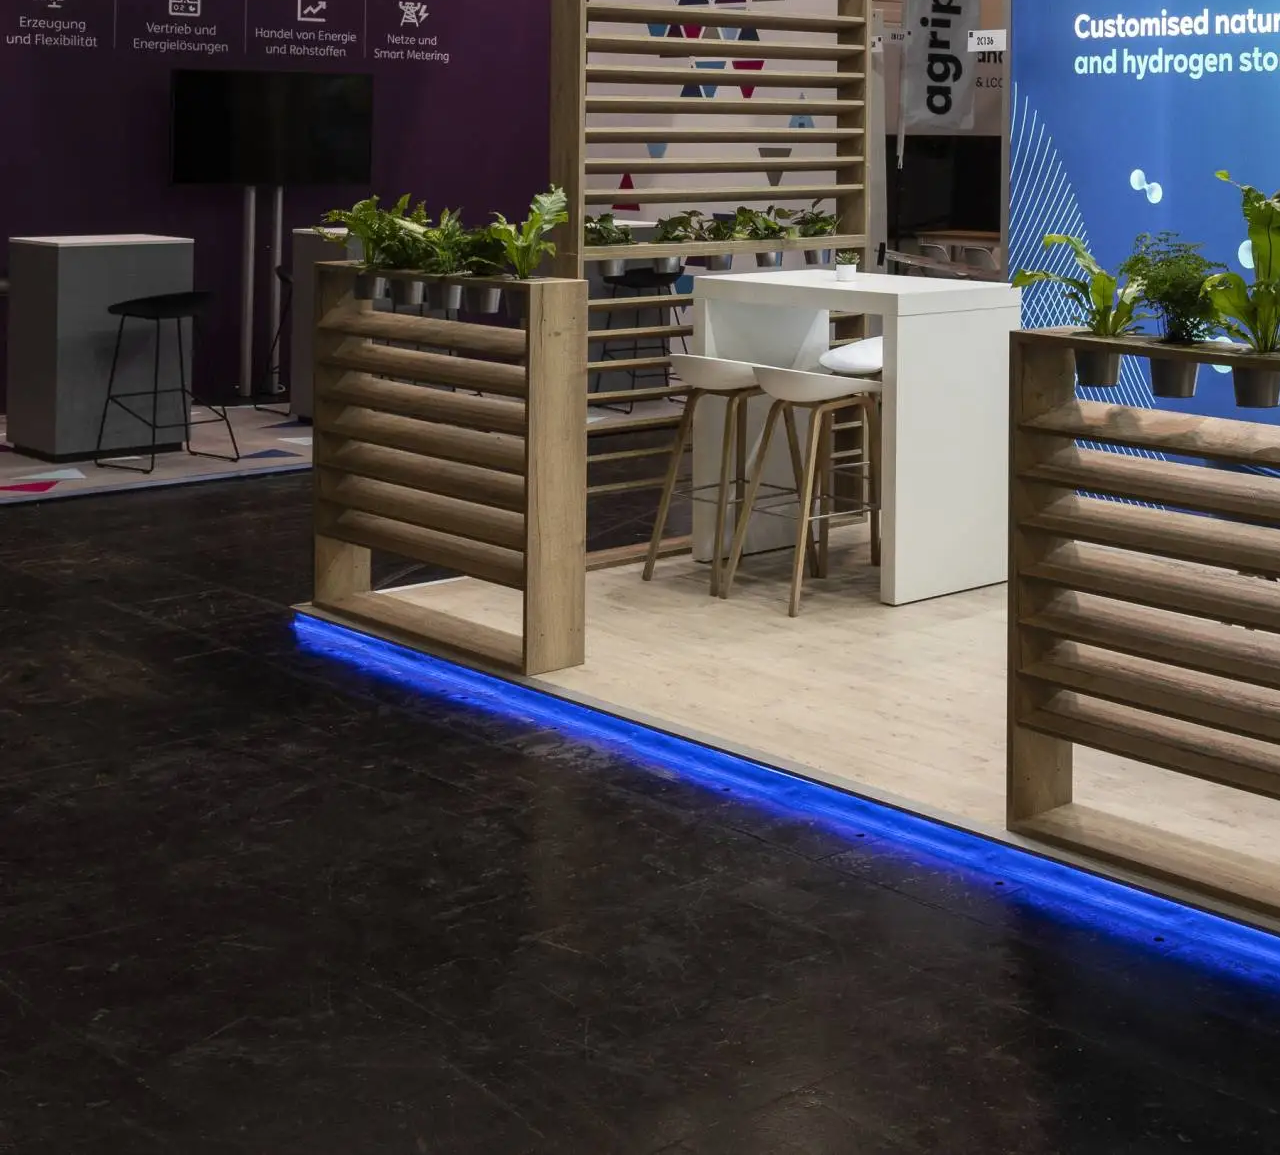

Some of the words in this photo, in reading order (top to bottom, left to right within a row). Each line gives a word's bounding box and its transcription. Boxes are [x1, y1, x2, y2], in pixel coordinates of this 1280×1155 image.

[19, 16, 87, 33] Erzeugung
[146, 21, 192, 35] Vertrieb
[194, 24, 217, 36] und
[1073, 9, 1209, 39] Customised
[6, 33, 31, 45] und
[35, 33, 98, 48] Flexibilität
[255, 27, 293, 40] Handel
[296, 30, 316, 41] von
[318, 30, 358, 44] Energie
[387, 34, 416, 45] Netze
[418, 34, 437, 46] und
[133, 38, 229, 54] Energielösungen
[265, 43, 287, 55] und
[289, 44, 347, 57] Rohstoffen
[374, 48, 405, 60] Smart
[407, 49, 450, 64] Metering
[1073, 49, 1117, 75] and
[1123, 47, 1233, 80] hydrogen
[975, 76, 983, 88] &
